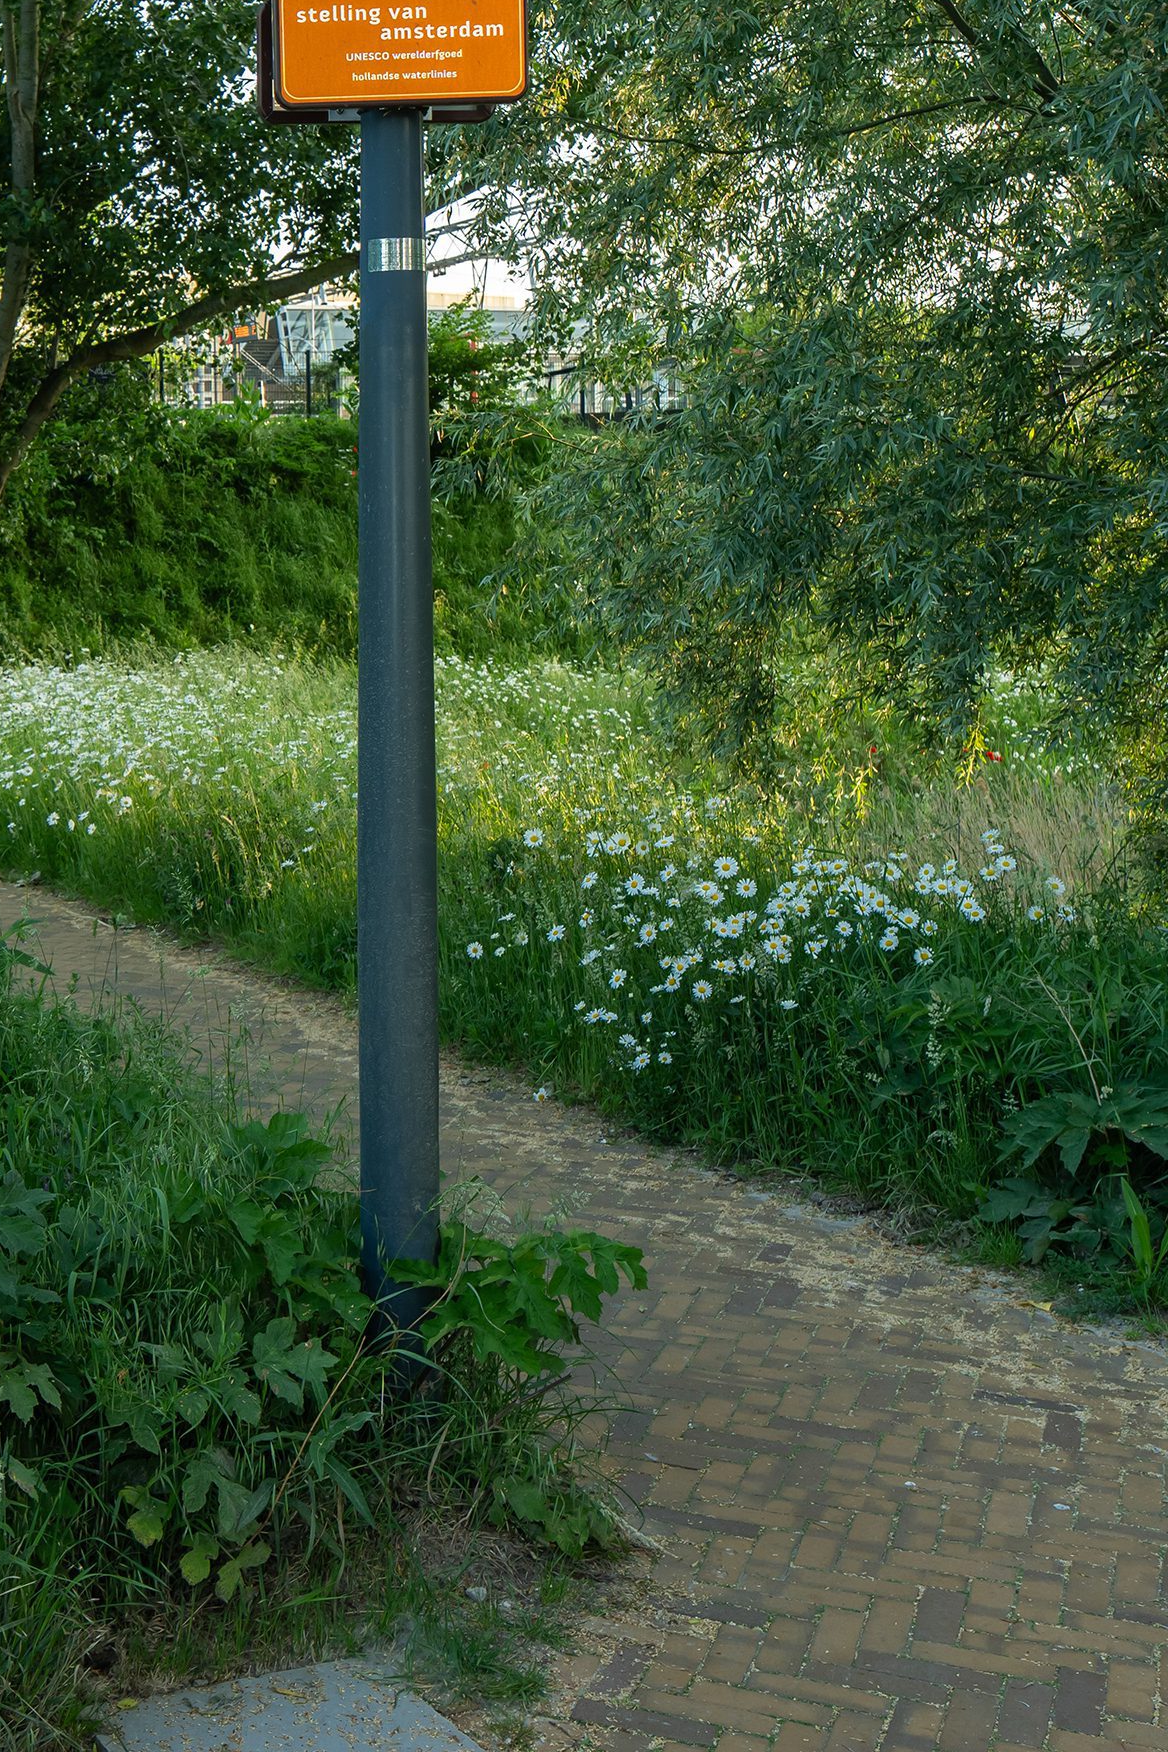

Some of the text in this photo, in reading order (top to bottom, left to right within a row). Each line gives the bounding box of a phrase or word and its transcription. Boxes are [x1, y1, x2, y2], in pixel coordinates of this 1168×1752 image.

[296, 4, 428, 25] stelling van
[380, 20, 504, 41] amsterdam
[345, 48, 463, 62] UNESCO werelderfgoed
[351, 69, 457, 82] hollandse waterlinies
